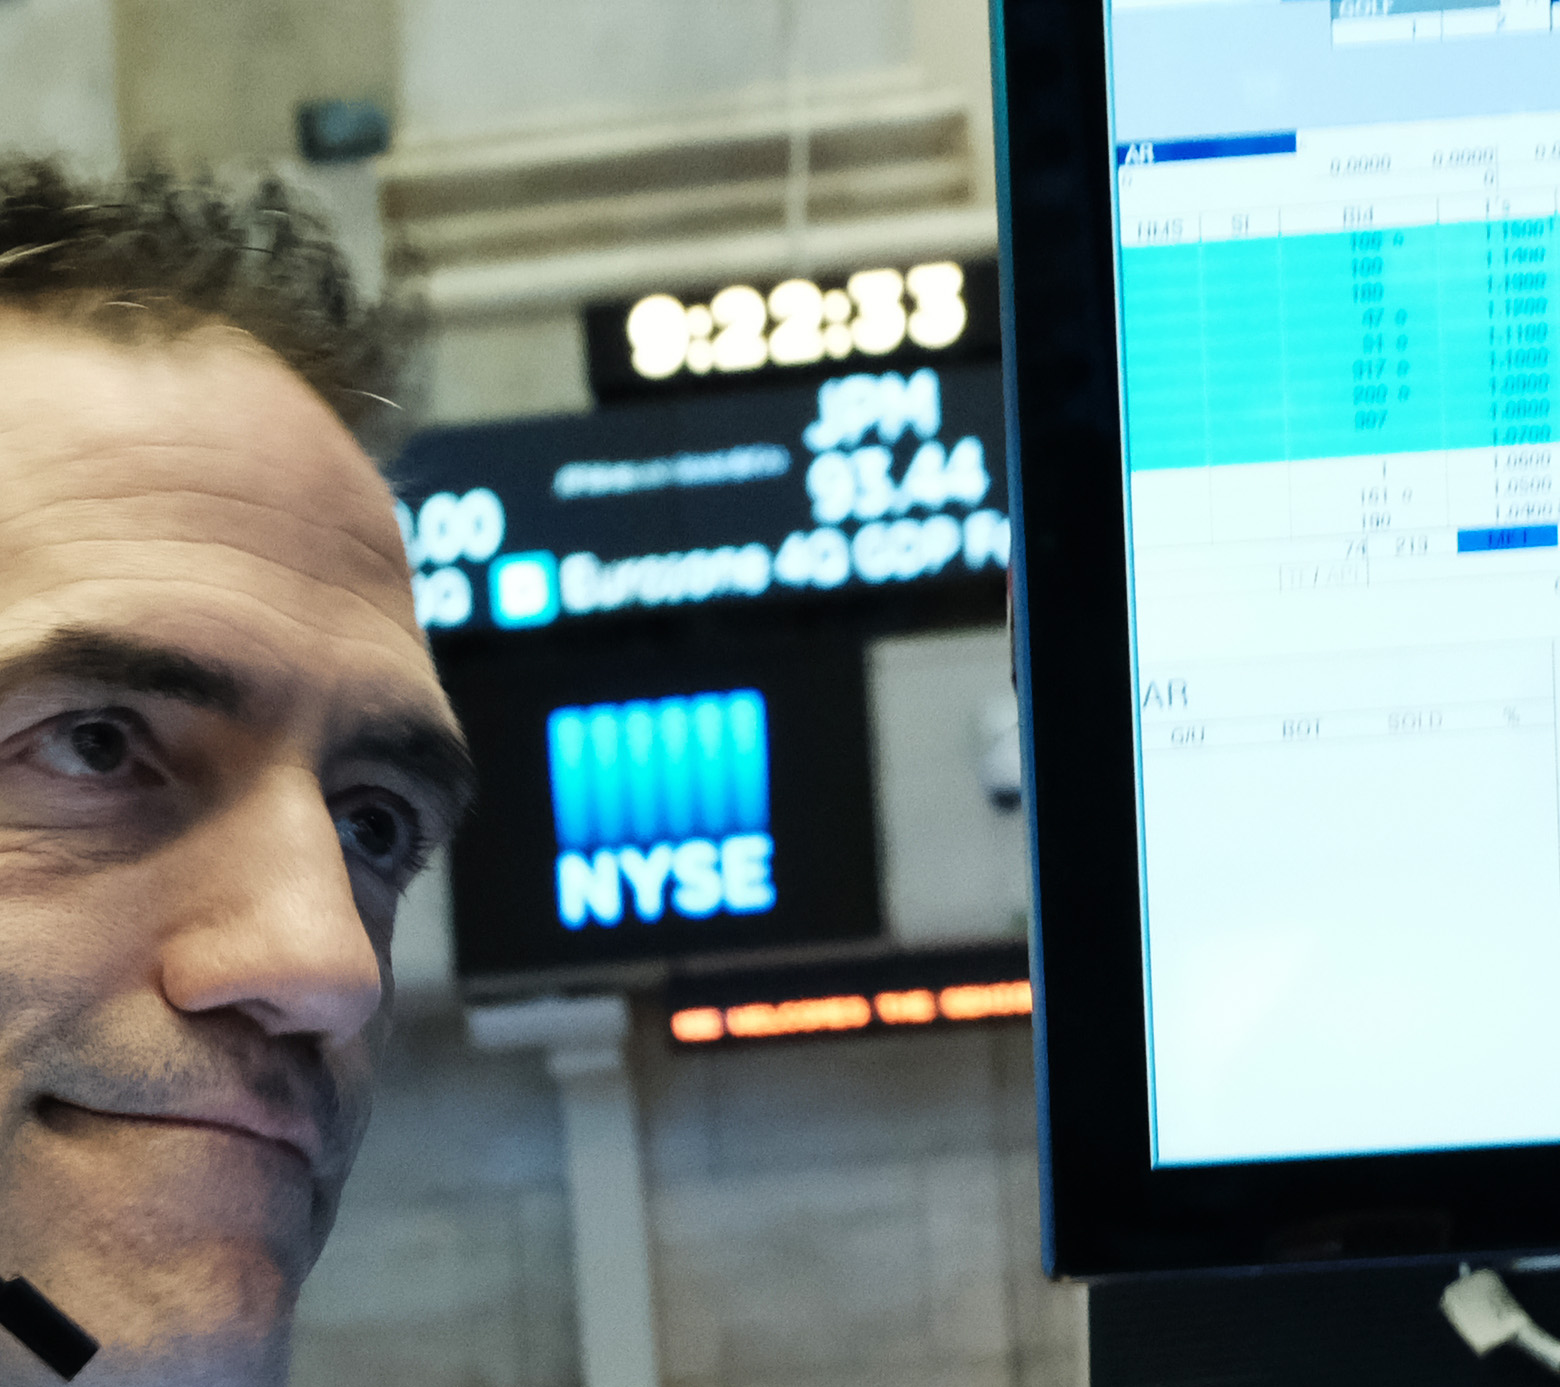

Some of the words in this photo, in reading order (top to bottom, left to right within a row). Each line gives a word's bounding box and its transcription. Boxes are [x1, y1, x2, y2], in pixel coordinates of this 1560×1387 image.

[1123, 143, 1155, 166] AR
[1143, 678, 1189, 708] AR
[557, 832, 777, 930] NYSE
